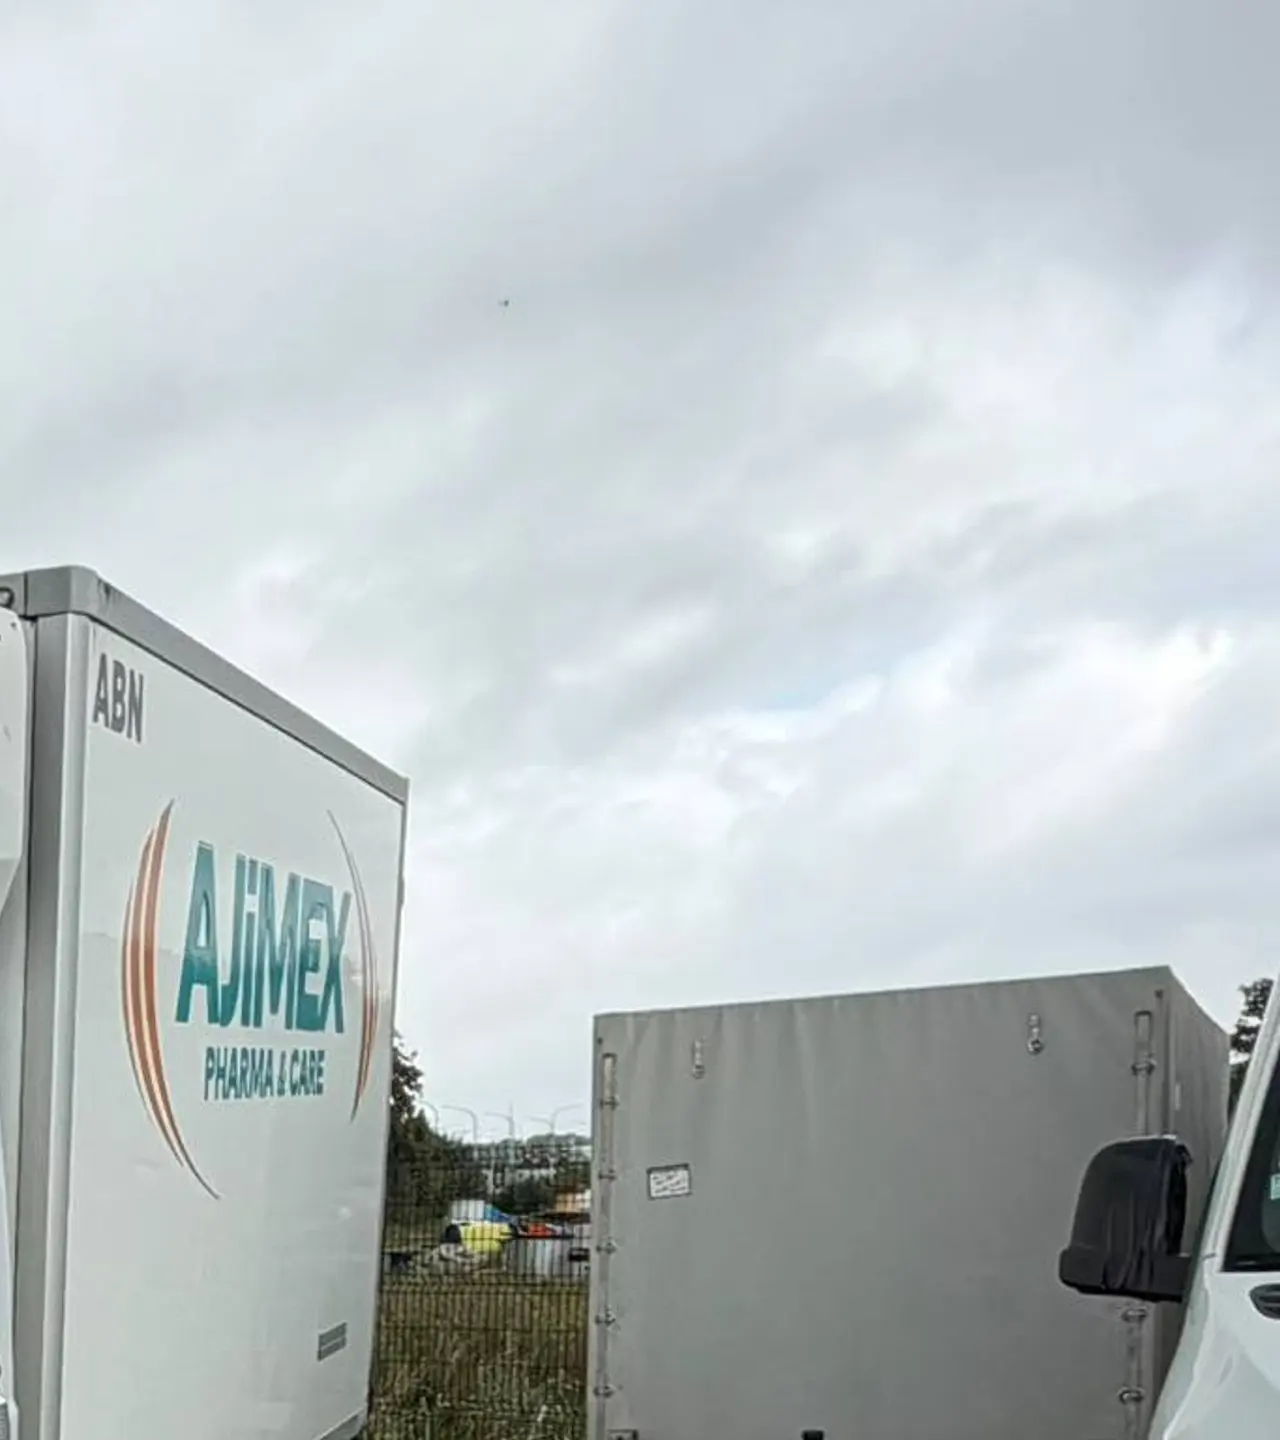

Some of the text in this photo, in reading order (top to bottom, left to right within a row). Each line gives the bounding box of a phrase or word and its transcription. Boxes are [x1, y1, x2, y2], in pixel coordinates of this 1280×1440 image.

[93, 652, 144, 744] ABN
[204, 1046, 325, 1101] PHARMA & CARE
